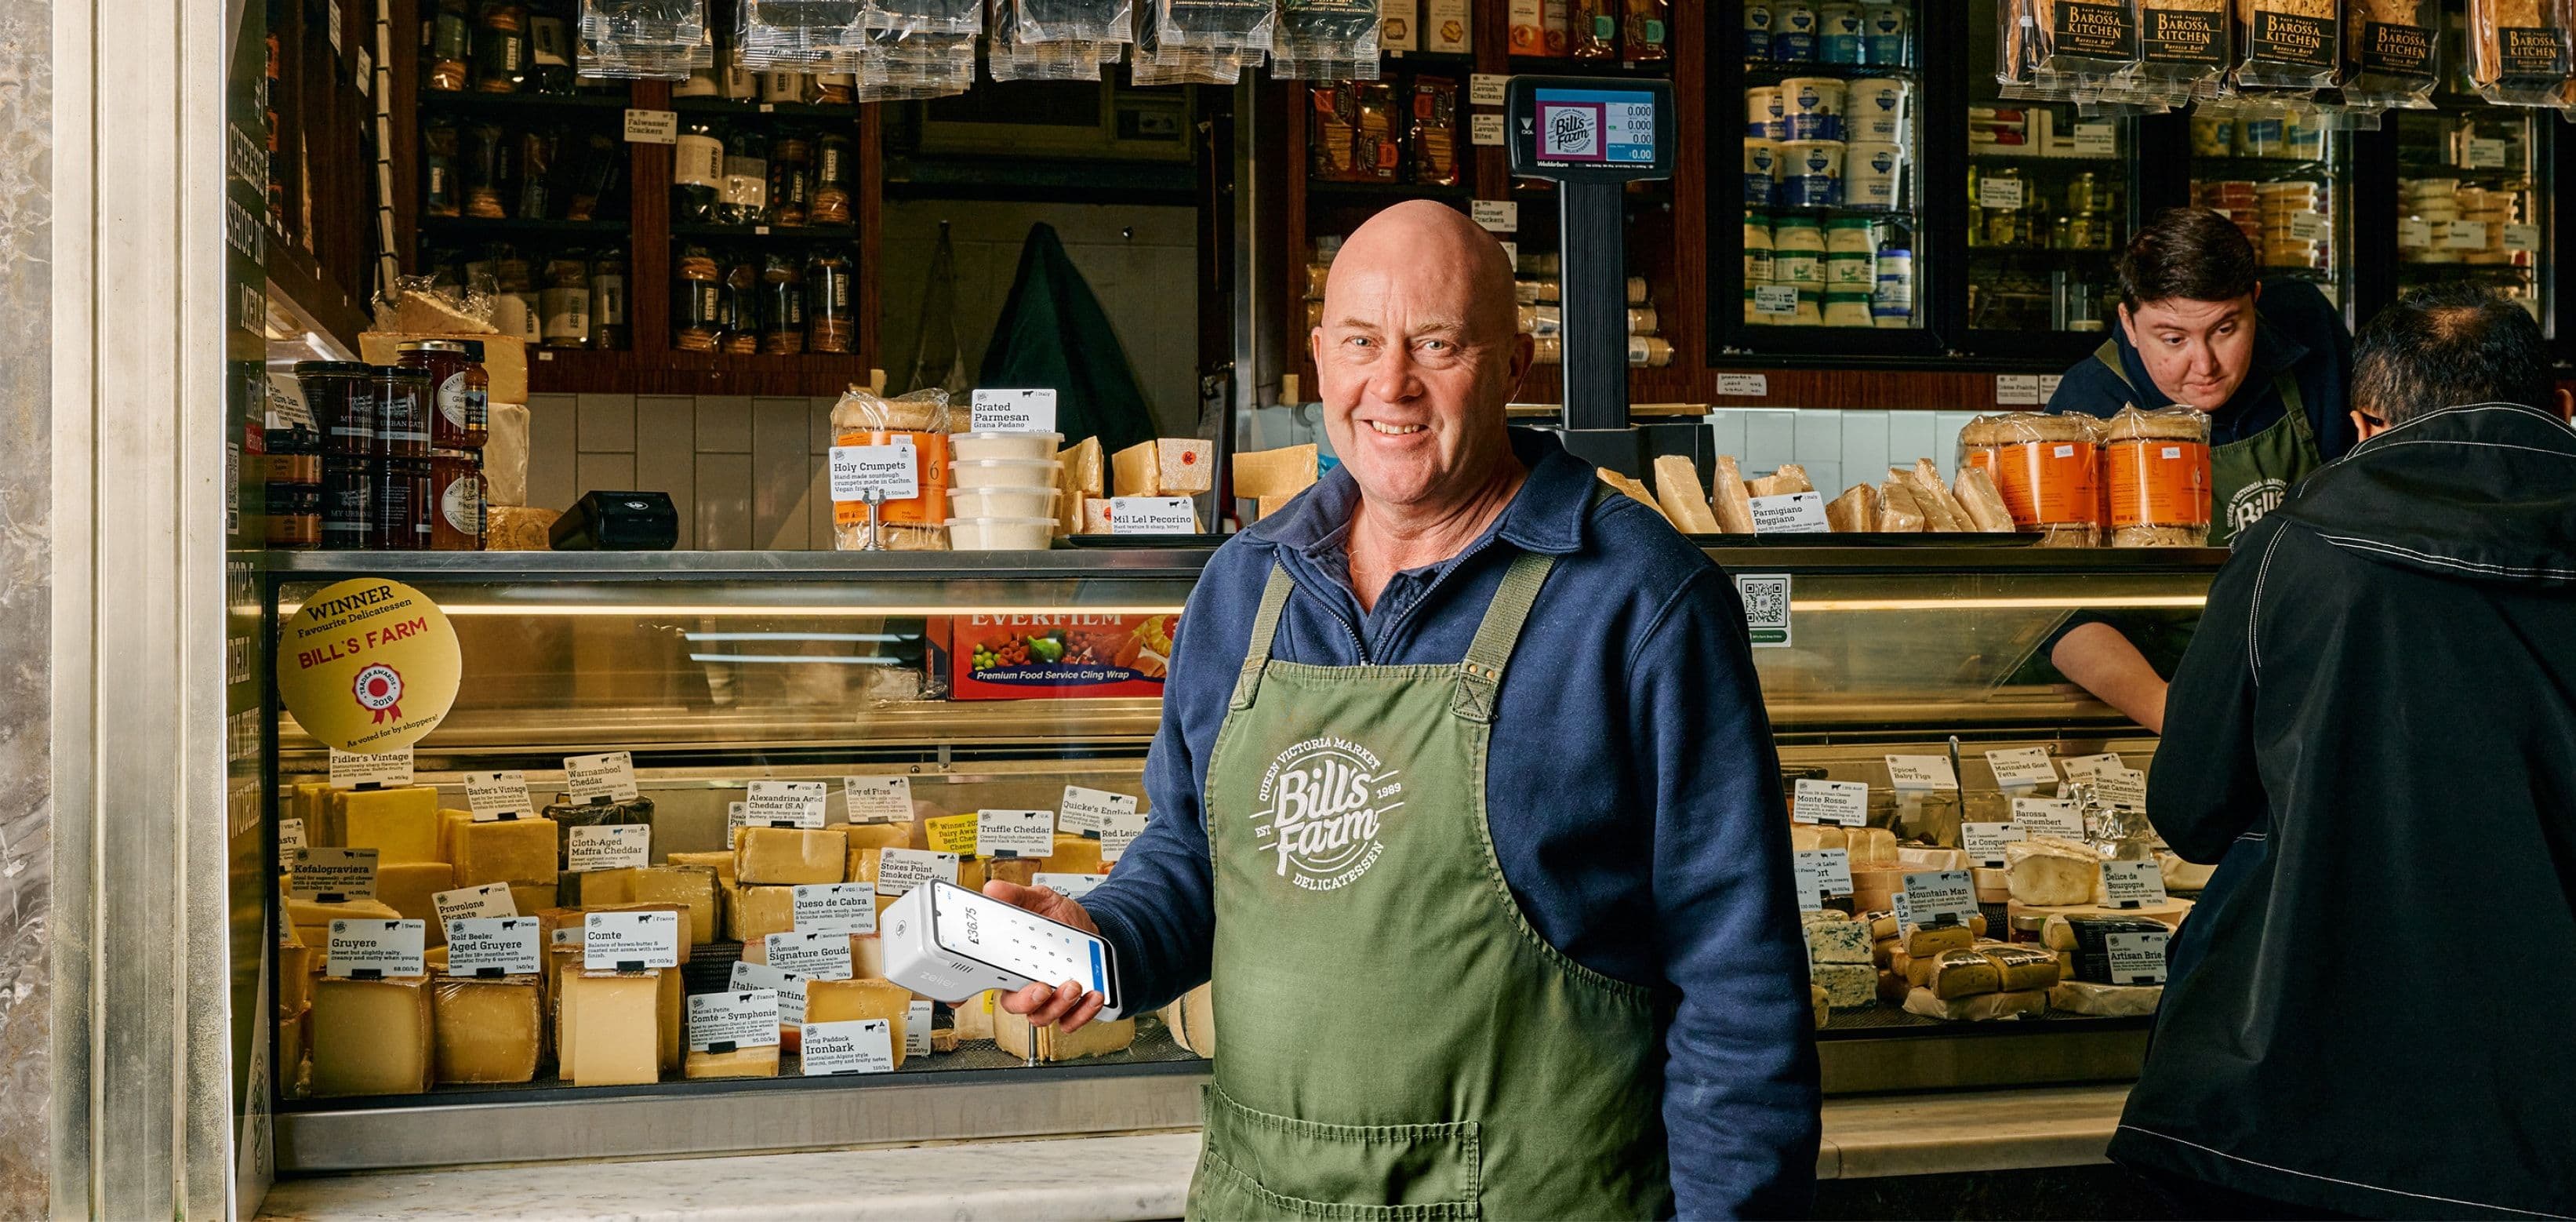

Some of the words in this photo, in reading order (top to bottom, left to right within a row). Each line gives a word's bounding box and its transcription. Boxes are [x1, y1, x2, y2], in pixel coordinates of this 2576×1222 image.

[2069, 6, 2121, 26] BAROSSA
[2158, 13, 2210, 31] BAROSSA
[2069, 24, 2121, 38] KITCHEN
[2267, 15, 2320, 36] BAROSSA
[2158, 30, 2211, 44] KITCHEN
[2267, 31, 2320, 49] KITCHEN
[2378, 27, 2425, 46] BAROSSA
[2510, 31, 2556, 46] BAROSSA
[2376, 44, 2425, 58] KITCHEN
[2511, 47, 2556, 58] KITCHEN
[1627, 106, 1651, 117] 0.000
[1556, 115, 1585, 136] Bill's
[1628, 121, 1651, 130] 0.000
[1557, 128, 1589, 151] Farm
[1633, 134, 1651, 144] 0.00
[230, 122, 265, 197] CHEESE
[227, 197, 254, 258] SHOP
[255, 220, 264, 268] IN
[975, 402, 1011, 411] Grated
[834, 464, 857, 472] Holy
[859, 462, 906, 471] Crumpets
[930, 460, 939, 480] 6
[2227, 503, 2236, 527] QUEEN
[2232, 481, 2264, 503] VICTORIA
[1753, 507, 1803, 517] Parmigiano
[1756, 516, 1795, 526] Reggiano
[227, 561, 247, 612] TOP
[306, 585, 394, 622] WINNER
[297, 618, 347, 639] Favourite
[348, 598, 412, 623] Delicatessen
[972, 614, 1122, 626] EVERFILM
[297, 638, 361, 669] BILL'S
[365, 616, 428, 649] FARM
[227, 636, 250, 685] DELI
[360, 673, 372, 695] TRADER
[372, 669, 396, 686] AWARDS
[976, 671, 1017, 680] Premium
[1019, 671, 1043, 680] Food
[1045, 671, 1078, 679] Service
[1081, 671, 1104, 681] Cling
[1106, 671, 1129, 682] Wrap
[228, 715, 239, 762] IN
[241, 707, 260, 757] THE
[358, 733, 380, 744] voted
[380, 728, 391, 737] for
[392, 726, 401, 736] by
[402, 715, 438, 731] shoppers!
[569, 766, 621, 777] Warrnambool
[1259, 762, 1280, 802] QUEEN
[1277, 737, 1331, 763] VICTORIA
[1333, 737, 1381, 770] MARKET
[1995, 763, 2030, 772] Marinated
[570, 778, 602, 787] Cheddar
[2112, 784, 2145, 794] Camembert
[468, 787, 498, 795] Barber's
[1274, 759, 1373, 828] Bill's
[1375, 783, 1402, 799] 1989
[228, 780, 260, 839] WORLD
[1063, 801, 1099, 813] Quicke's
[1255, 825, 1272, 838] EST
[572, 838, 622, 847] Cloth-Aged
[1277, 808, 1381, 877] Farm
[294, 865, 369, 875] Kefalograviera
[1292, 840, 1384, 891] DELICATESSEN
[1909, 890, 1948, 899] Mountain
[439, 900, 485, 914] Provolone
[796, 900, 823, 909] Queso
[965, 907, 980, 945] £36.75
[332, 939, 376, 948] Gruyere
[450, 943, 477, 952] Aged
[480, 941, 522, 951] Gruyere
[769, 950, 819, 961] Signature
[2111, 951, 2142, 960] Artisan
[2145, 951, 2162, 959] Brie
[692, 1013, 718, 1023] Comté
[728, 1009, 777, 1020] Symphonie
[806, 1043, 855, 1054] Ironbark
